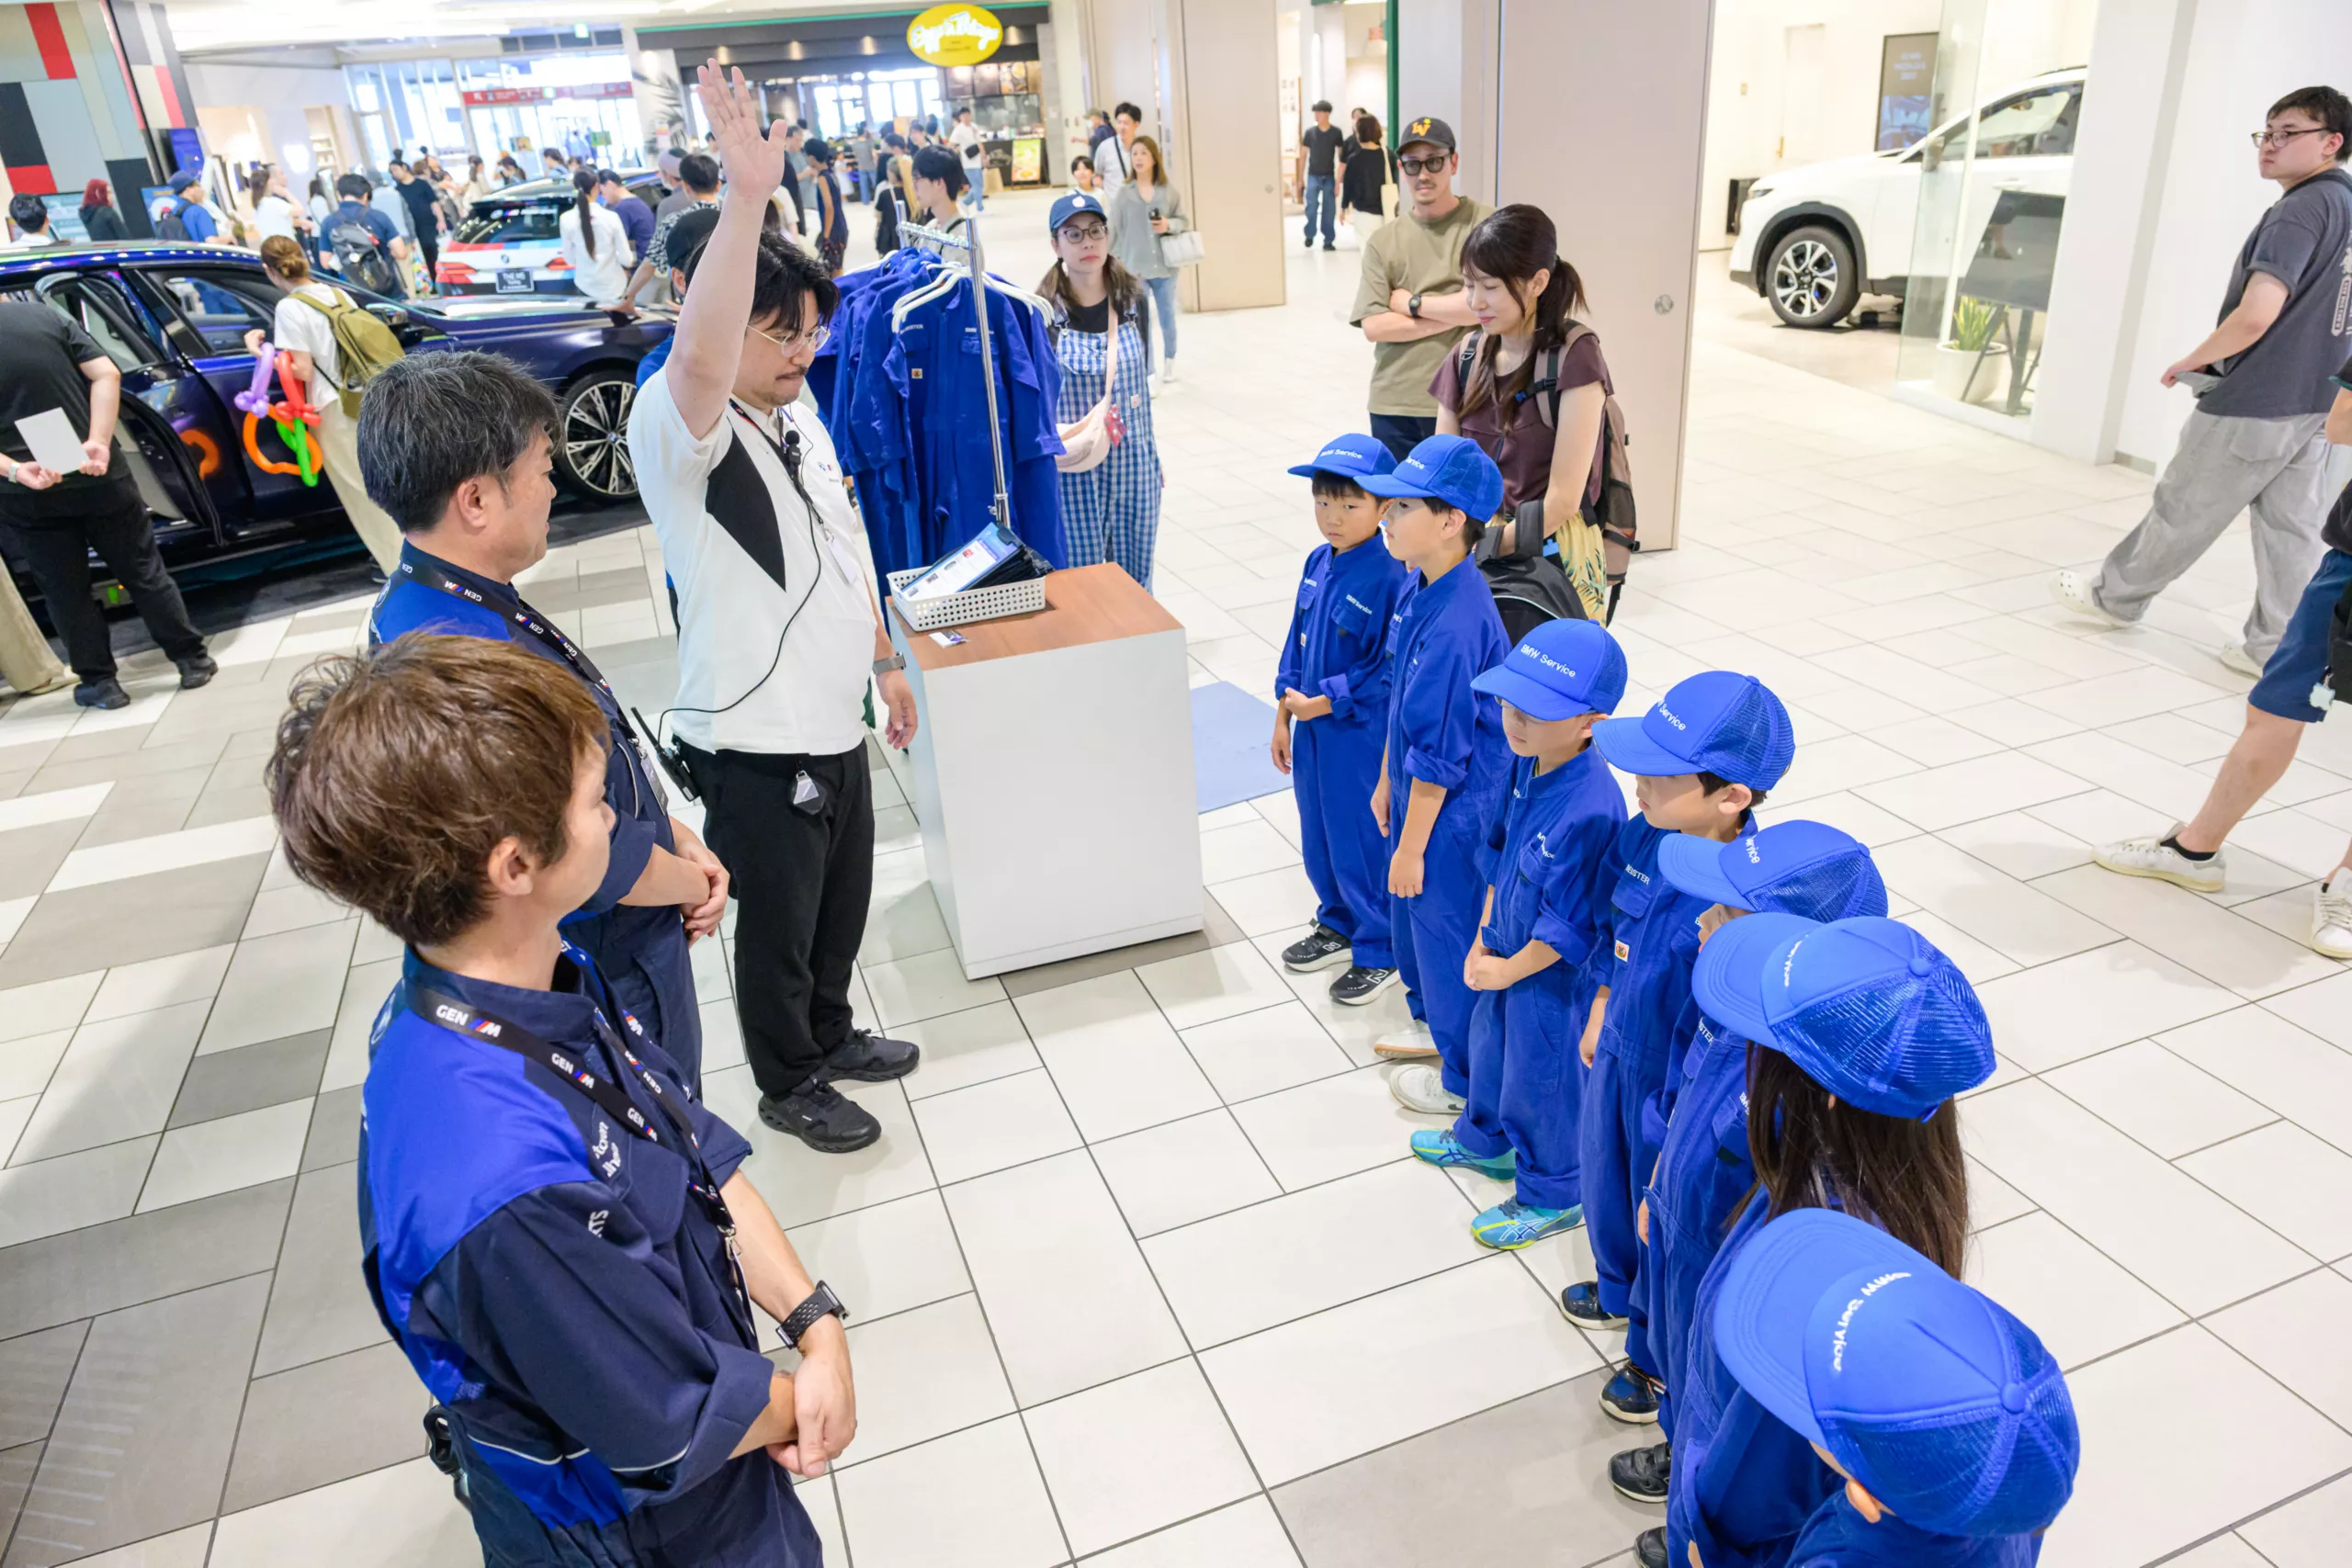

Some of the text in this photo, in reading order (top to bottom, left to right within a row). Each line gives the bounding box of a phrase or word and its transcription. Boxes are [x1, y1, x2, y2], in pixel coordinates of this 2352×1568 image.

[464, 589, 482, 603] GEN
[529, 622, 545, 635] GEN
[1521, 644, 1576, 678] BMW Service
[1659, 703, 1687, 731] Service
[435, 1004, 469, 1026] GEN
[551, 1053, 574, 1075] GEN
[643, 1071, 662, 1094] GEN
[628, 1107, 644, 1128] GEN
[1833, 1299, 1864, 1371] Service
